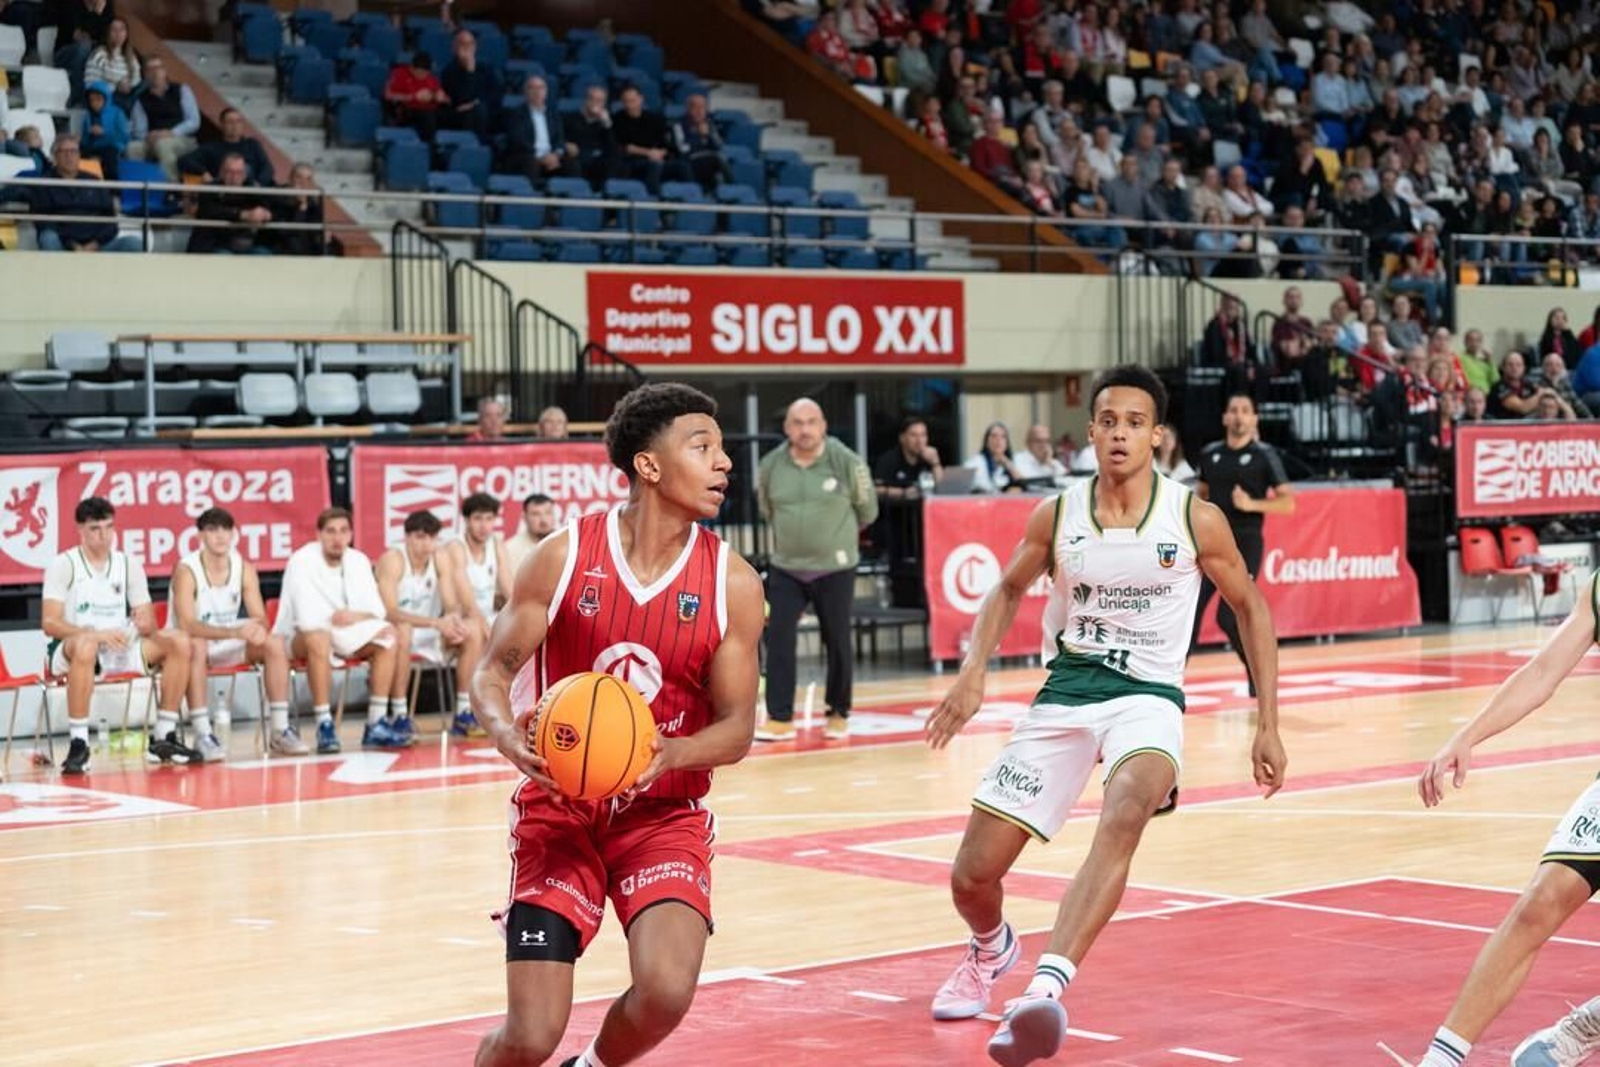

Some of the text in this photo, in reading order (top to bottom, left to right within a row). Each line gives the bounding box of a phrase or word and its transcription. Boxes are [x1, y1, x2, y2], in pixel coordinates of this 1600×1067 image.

[630, 283, 691, 304] Centro
[605, 308, 691, 332] Deportivo
[711, 303, 954, 354] SIGLO XXI
[606, 333, 692, 357] Municipal
[79, 461, 294, 518] Zaragoza
[1517, 470, 1542, 498] DE
[1264, 546, 1400, 584] Casademont
[679, 593, 700, 603] LIGA
[1097, 584, 1172, 597] Fundación
[1098, 597, 1150, 613] Unicaja
